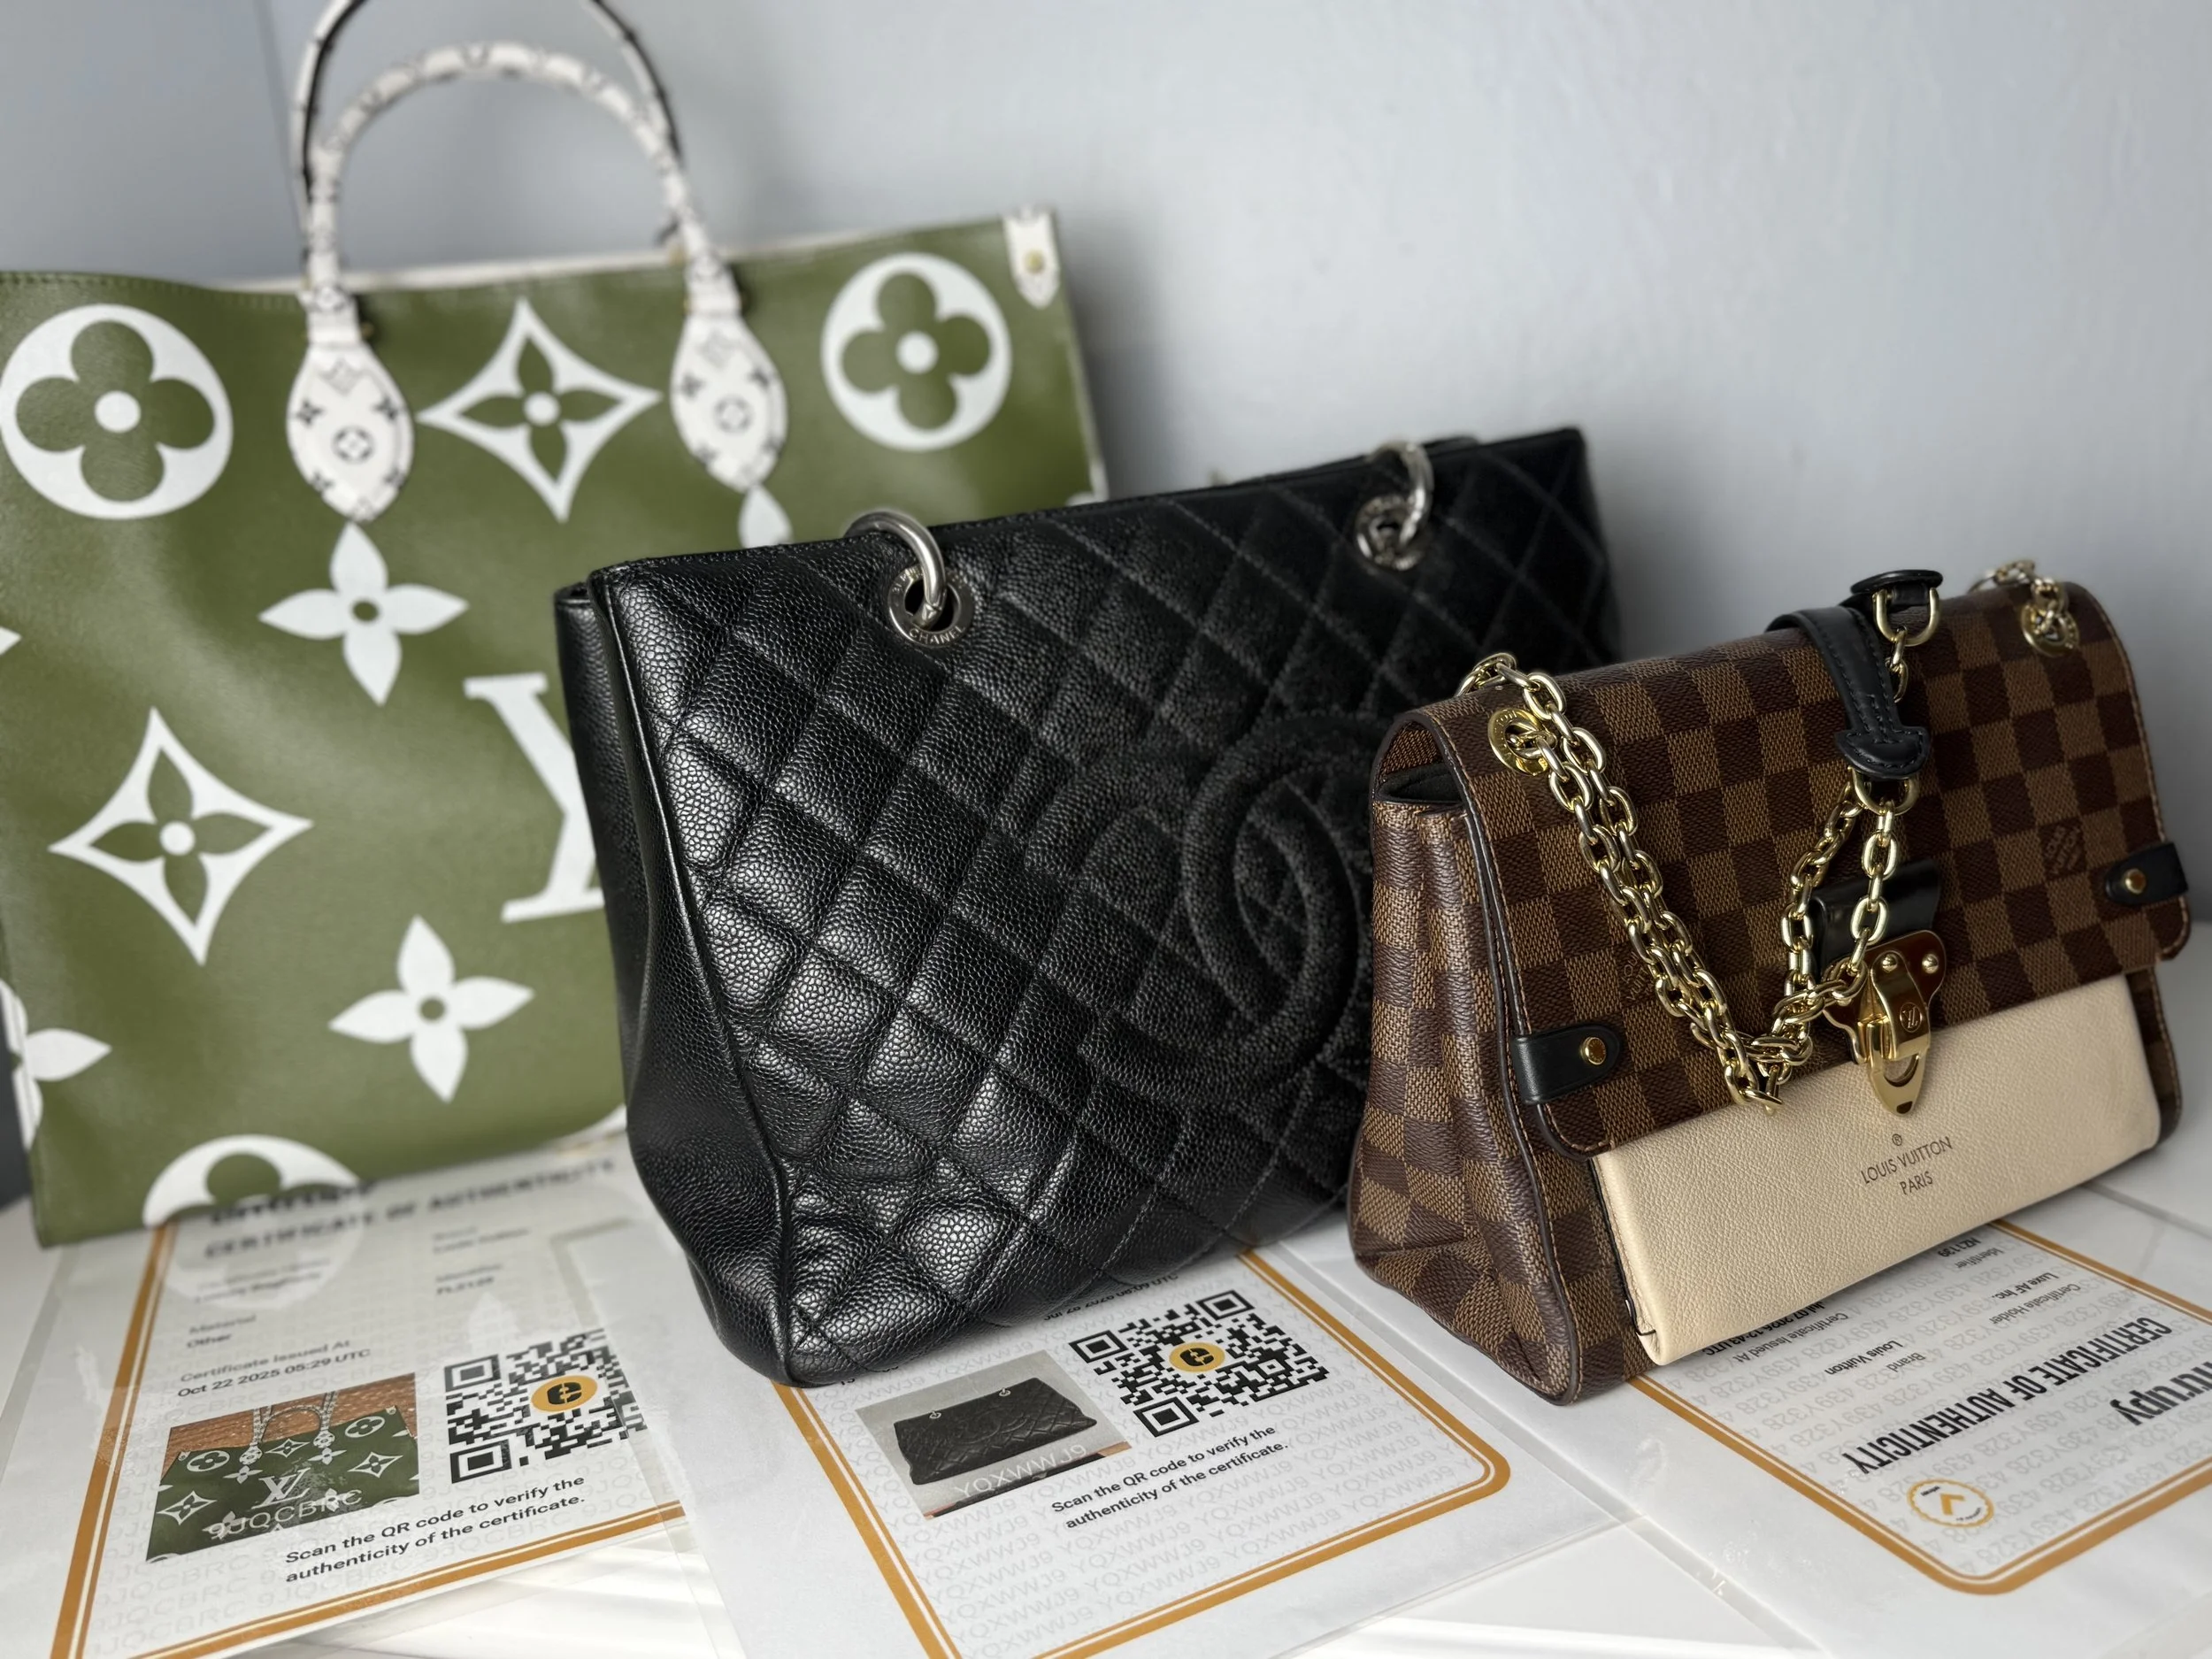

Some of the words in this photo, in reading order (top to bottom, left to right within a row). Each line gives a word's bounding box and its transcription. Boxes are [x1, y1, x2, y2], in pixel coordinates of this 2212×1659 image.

[1861, 1158, 1898, 1184] LOUIS
[1896, 1136, 1953, 1168] VUITTON
[1900, 1171, 1933, 1195] PARIS
[1938, 1237, 1980, 1257] NZ1139
[1955, 1248, 2003, 1268] Identifier
[2015, 1283, 2032, 1294] AF
[2027, 1273, 2058, 1285] Luxe
[1992, 1289, 2017, 1299] Inc.
[2024, 1284, 2081, 1308] Certificate
[1787, 1313, 1848, 1338] Certificate
[1989, 1306, 2030, 1324] Holder
[1701, 1341, 1732, 1355] UTC
[1732, 1353, 1750, 1363] At
[1748, 1337, 1792, 1357] Issued
[1866, 1340, 1903, 1356] Louis
[2028, 1317, 2172, 1386] CERTIFICATE
[177, 1385, 208, 1397] Oct
[211, 1379, 234, 1391] 22
[238, 1369, 280, 1385] 2025
[285, 1357, 332, 1375] 05:29
[335, 1348, 372, 1364] UTC
[180, 1360, 269, 1383] Certificate
[273, 1342, 328, 1363] Issued
[331, 1340, 350, 1351] At
[1824, 1356, 1871, 1374] Vuitton
[1886, 1353, 1925, 1372] Brand
[2003, 1376, 2047, 1401] OF
[1842, 1388, 2016, 1474] AUTHENTICITY
[955, 1444, 1087, 1498] YQXWWJ9
[1052, 1494, 1093, 1511] Scan
[1094, 1484, 1121, 1497] the
[1124, 1472, 1148, 1486] QR
[1150, 1460, 1187, 1477] code
[1207, 1437, 1248, 1455] verify
[1249, 1428, 1275, 1440] the
[1066, 1489, 1157, 1528] authenticity
[1162, 1479, 1177, 1492] of
[1179, 1472, 1206, 1485] the
[1209, 1444, 1287, 1474] certificate.
[286, 1545, 335, 1563] Scan
[342, 1534, 374, 1548] the
[381, 1523, 410, 1537] QR
[416, 1510, 464, 1527] code
[469, 1503, 488, 1513] to
[495, 1487, 548, 1506] verify
[553, 1478, 584, 1491] the
[287, 1543, 409, 1582] authenticity
[416, 1532, 435, 1547] of
[441, 1525, 472, 1539] the
[480, 1497, 584, 1528] certificate.
